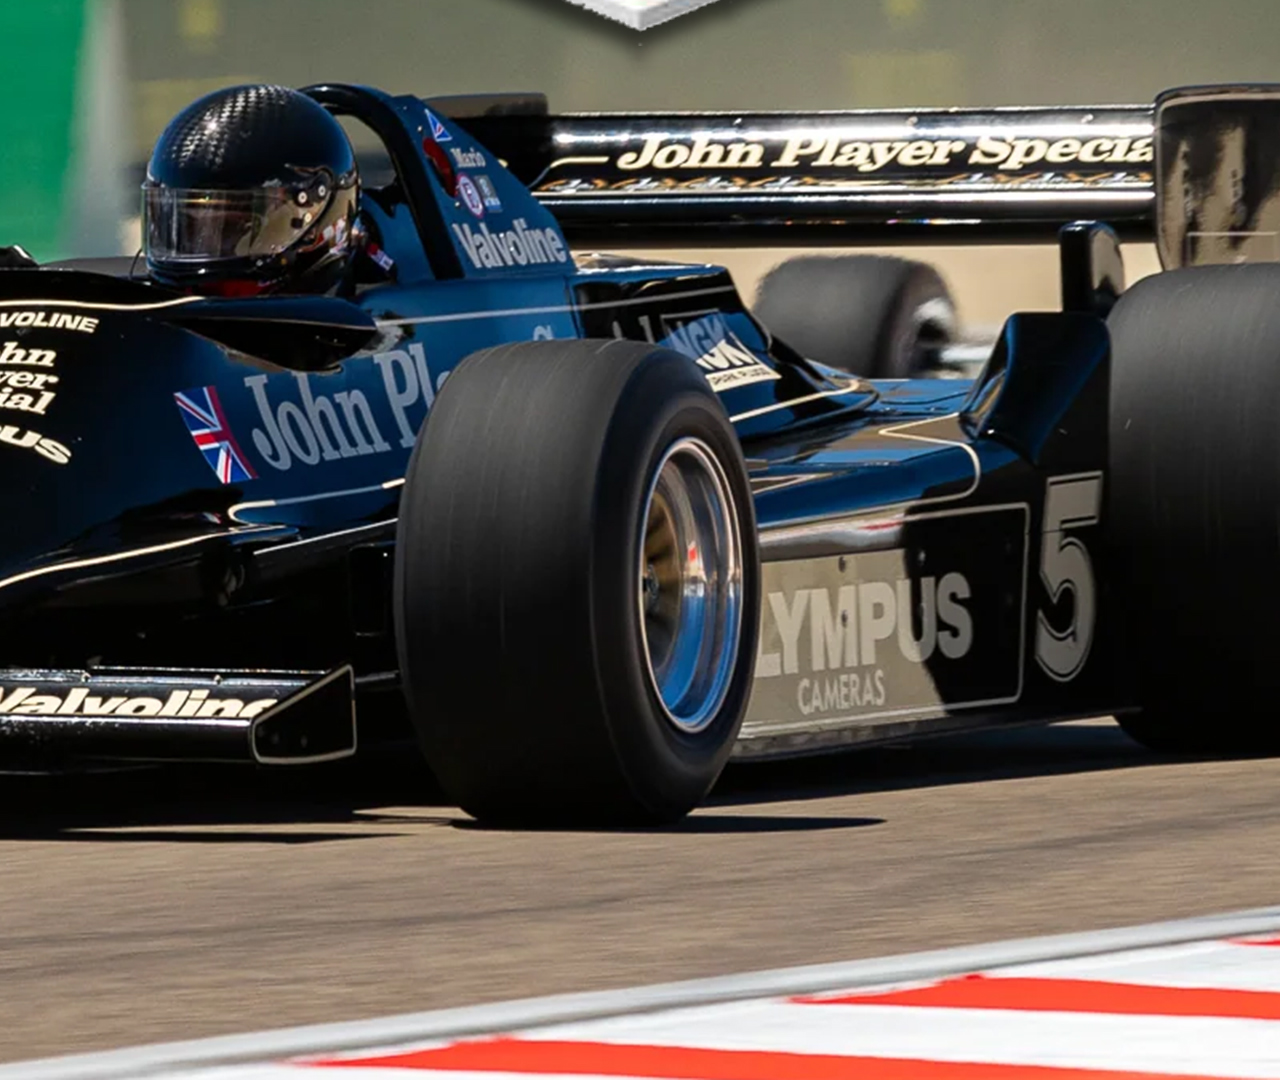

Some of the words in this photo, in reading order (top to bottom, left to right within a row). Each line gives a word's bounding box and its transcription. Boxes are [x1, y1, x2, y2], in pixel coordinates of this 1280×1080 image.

[616, 135, 765, 170] John
[770, 134, 966, 172] Player
[968, 135, 1153, 170] Specia
[452, 218, 567, 268] Valvoline
[243, 370, 392, 471] John
[1034, 471, 1104, 682] 5
[754, 572, 973, 678] LYMPUS
[797, 670, 886, 716] CAMERAS
